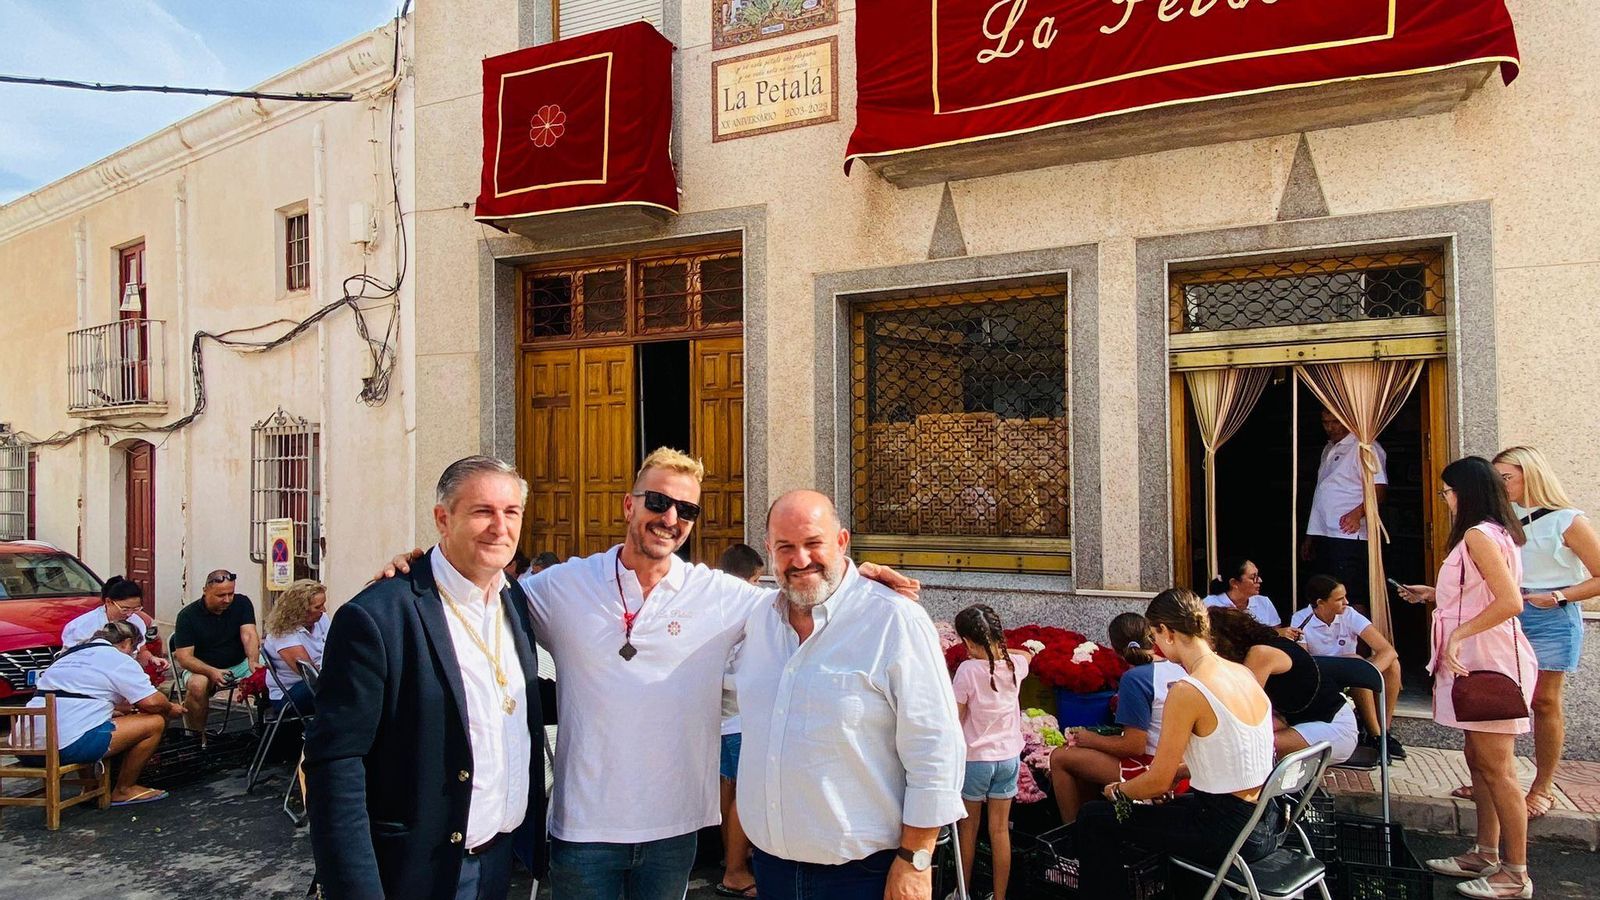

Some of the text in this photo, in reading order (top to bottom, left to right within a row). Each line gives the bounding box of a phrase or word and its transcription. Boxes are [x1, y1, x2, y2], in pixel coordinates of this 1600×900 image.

[976, 0, 1058, 64] La
[723, 68, 824, 112] La Petalá
